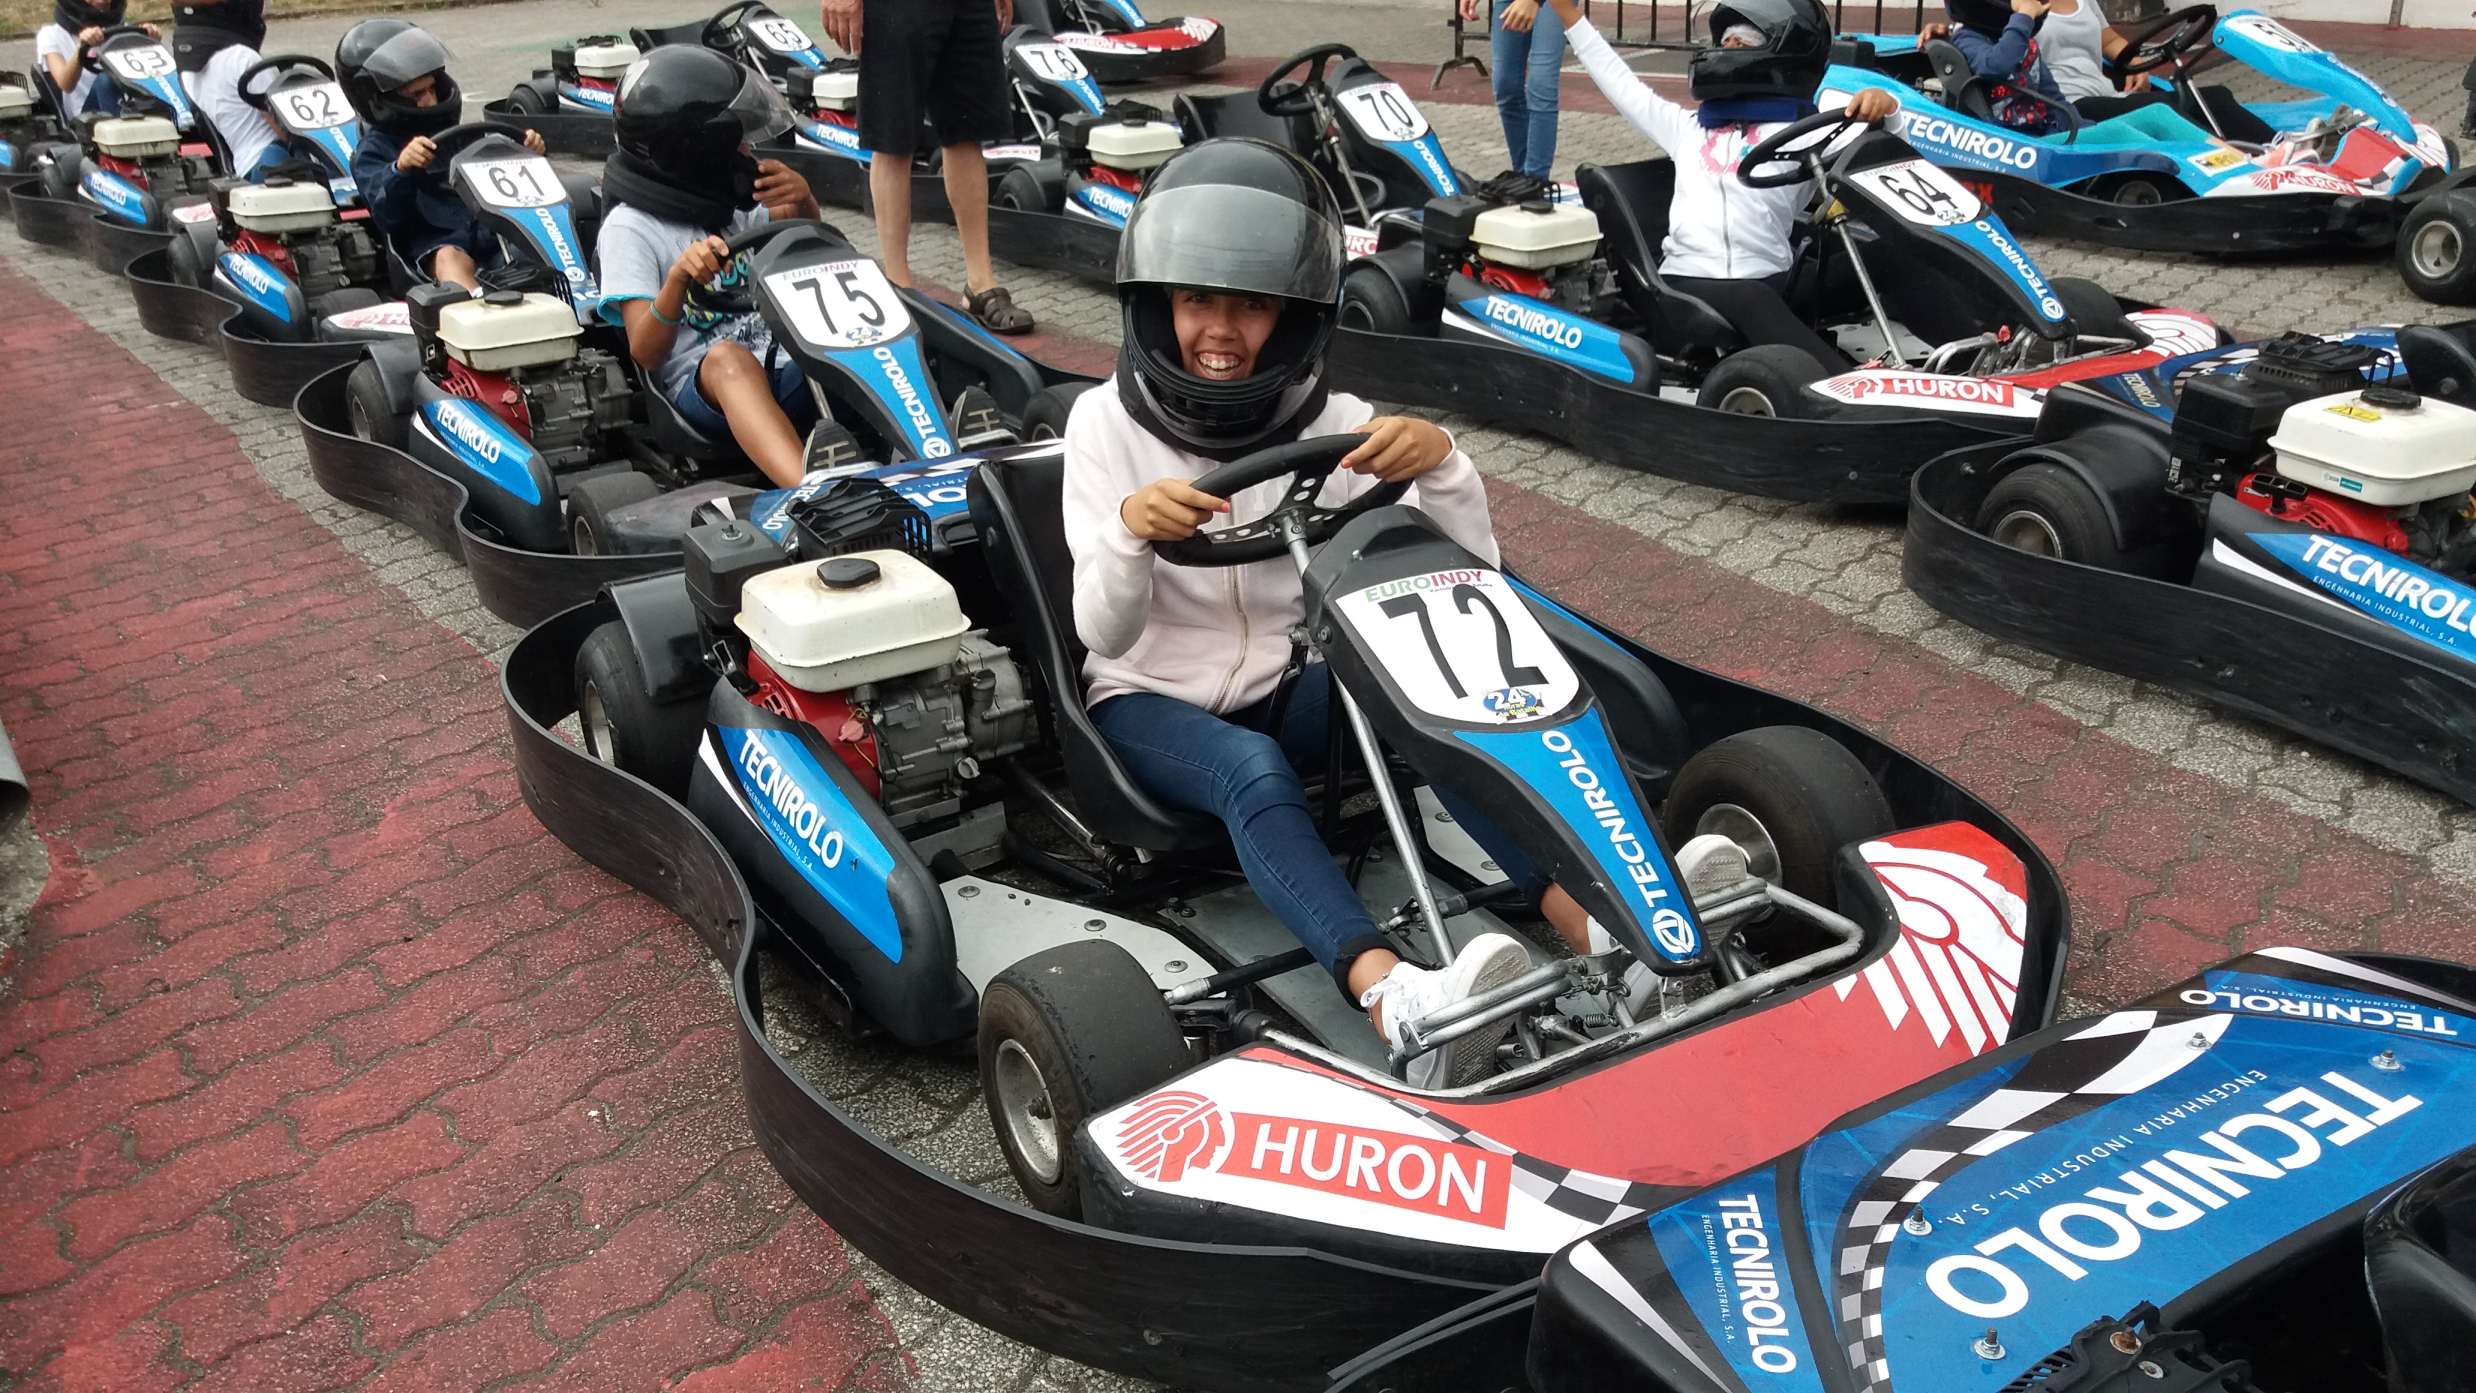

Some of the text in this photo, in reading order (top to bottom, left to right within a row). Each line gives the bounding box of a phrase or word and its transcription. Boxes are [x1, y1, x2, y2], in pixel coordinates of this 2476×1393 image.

[124, 50, 168, 72] 63
[765, 23, 802, 45] 65
[1030, 48, 1079, 74] 76
[290, 89, 338, 122] 62
[577, 88, 614, 105] TECNIRO
[1357, 90, 1414, 131] 70
[815, 124, 861, 150] TECNIROL
[1901, 110, 2038, 170] TECNIROLO
[488, 165, 545, 198] 61
[1413, 141, 1455, 197] ECNIROLO
[1878, 168, 1959, 216] 64
[2287, 175, 2355, 195] HURON
[1089, 186, 1134, 219] TECNIRO
[536, 208, 576, 267] TECNIROLO
[1975, 220, 2050, 299] TECNIROLO
[782, 260, 859, 281] EUROINDY
[791, 270, 886, 335] 75
[1485, 295, 1582, 349] TECNIROLO
[873, 346, 937, 440] TECNIROLO
[1892, 378, 2005, 404] HURON
[437, 400, 501, 464] TECNIROLO
[1364, 570, 1483, 603] EUROINDY
[2302, 534, 2476, 640] TECNIROL
[2313, 575, 2372, 606] ENGENHARIA
[2374, 603, 2435, 636] INDUSTRIAL,
[1376, 582, 1550, 700] 72
[1487, 688, 1527, 710] 24
[738, 729, 843, 869] TECNIROLO
[1542, 731, 1669, 909] TECNIROLO
[2179, 989, 2459, 1037] TECNIROLO
[2331, 995, 2417, 1012] ENGENHARIA
[1250, 1121, 1488, 1214] HURON
[1937, 1068, 2269, 1227] ENGENHARIA INDUSTRIAL, S.A.
[1925, 1071, 2424, 1319] TECNIROLO
[1701, 1214, 1720, 1266] ENGENHARIA
[1712, 1265, 1731, 1323] INDUSTRIAL,
[1718, 1194, 1798, 1375] TECNIROLO
